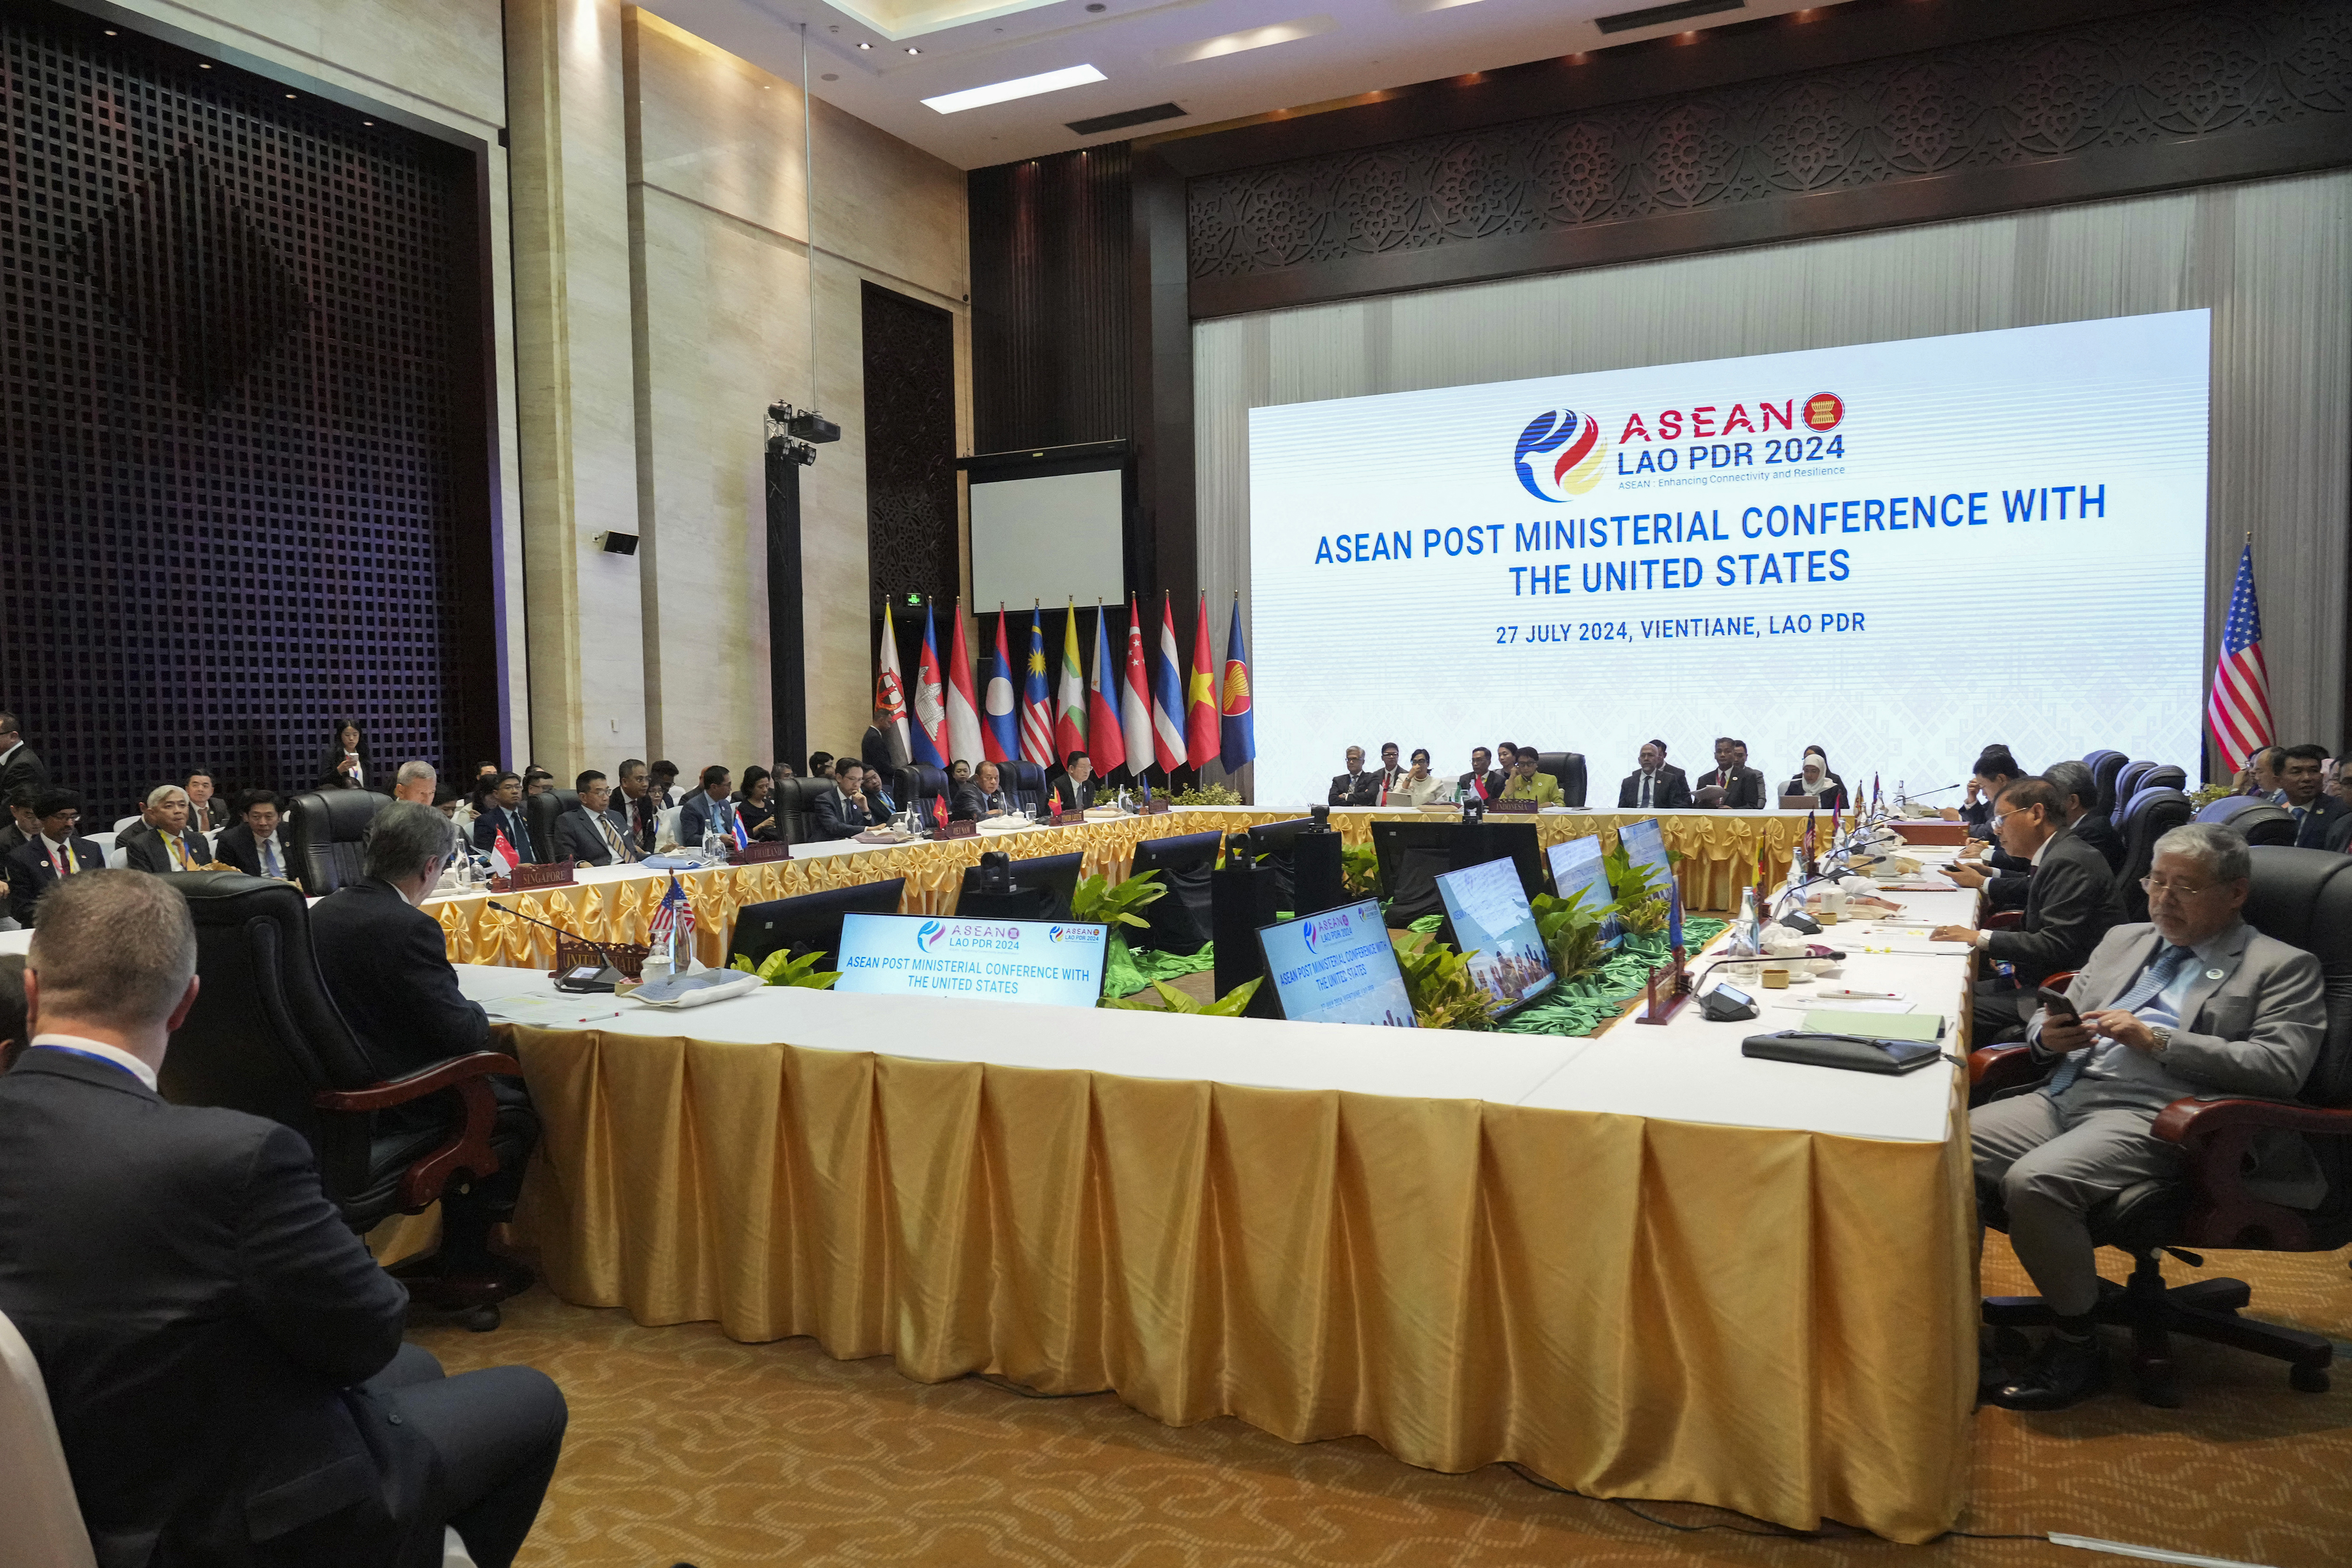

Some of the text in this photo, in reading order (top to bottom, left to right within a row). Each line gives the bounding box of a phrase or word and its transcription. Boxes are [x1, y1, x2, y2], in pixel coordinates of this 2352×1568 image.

[1619, 399, 1794, 444] ASEAN
[1618, 435, 1845, 475] LAO PDR 2024
[1618, 480, 1650, 490] ASEAN
[1658, 476, 1708, 487] Enhancing
[1709, 472, 1770, 483] Connectivity
[1772, 469, 1791, 479] and
[1794, 467, 1845, 477] Resilience
[1314, 484, 2105, 564] ASEAN POST MINISTERIAL CONFERENCE WITH
[1509, 548, 1850, 596] THE UNITED STATES
[1496, 612, 1865, 644] 27 JULY 2024, VIENTIANE, LAO PDR
[1496, 802, 1528, 811] INDONESIA
[754, 847, 781, 859] THAILAND
[523, 870, 565, 885] SINGAPORE
[952, 925, 1006, 938] ASEAN
[1319, 916, 1343, 932] ASEAN
[949, 938, 1019, 950] LAO PDR 2024
[1320, 932, 1331, 943] LAO
[846, 956, 1089, 982] ASEAN POST MINISTERIAL CONFERENCE WITH
[1279, 968, 1299, 987] ASEAN
[1298, 964, 1314, 980] POST
[1311, 952, 1347, 974] MINISTERIAL
[1345, 943, 1378, 962] CONFERENCE
[908, 975, 1018, 994] THE UNITED STATES
[1316, 964, 1367, 991] THE UNITED STATES
